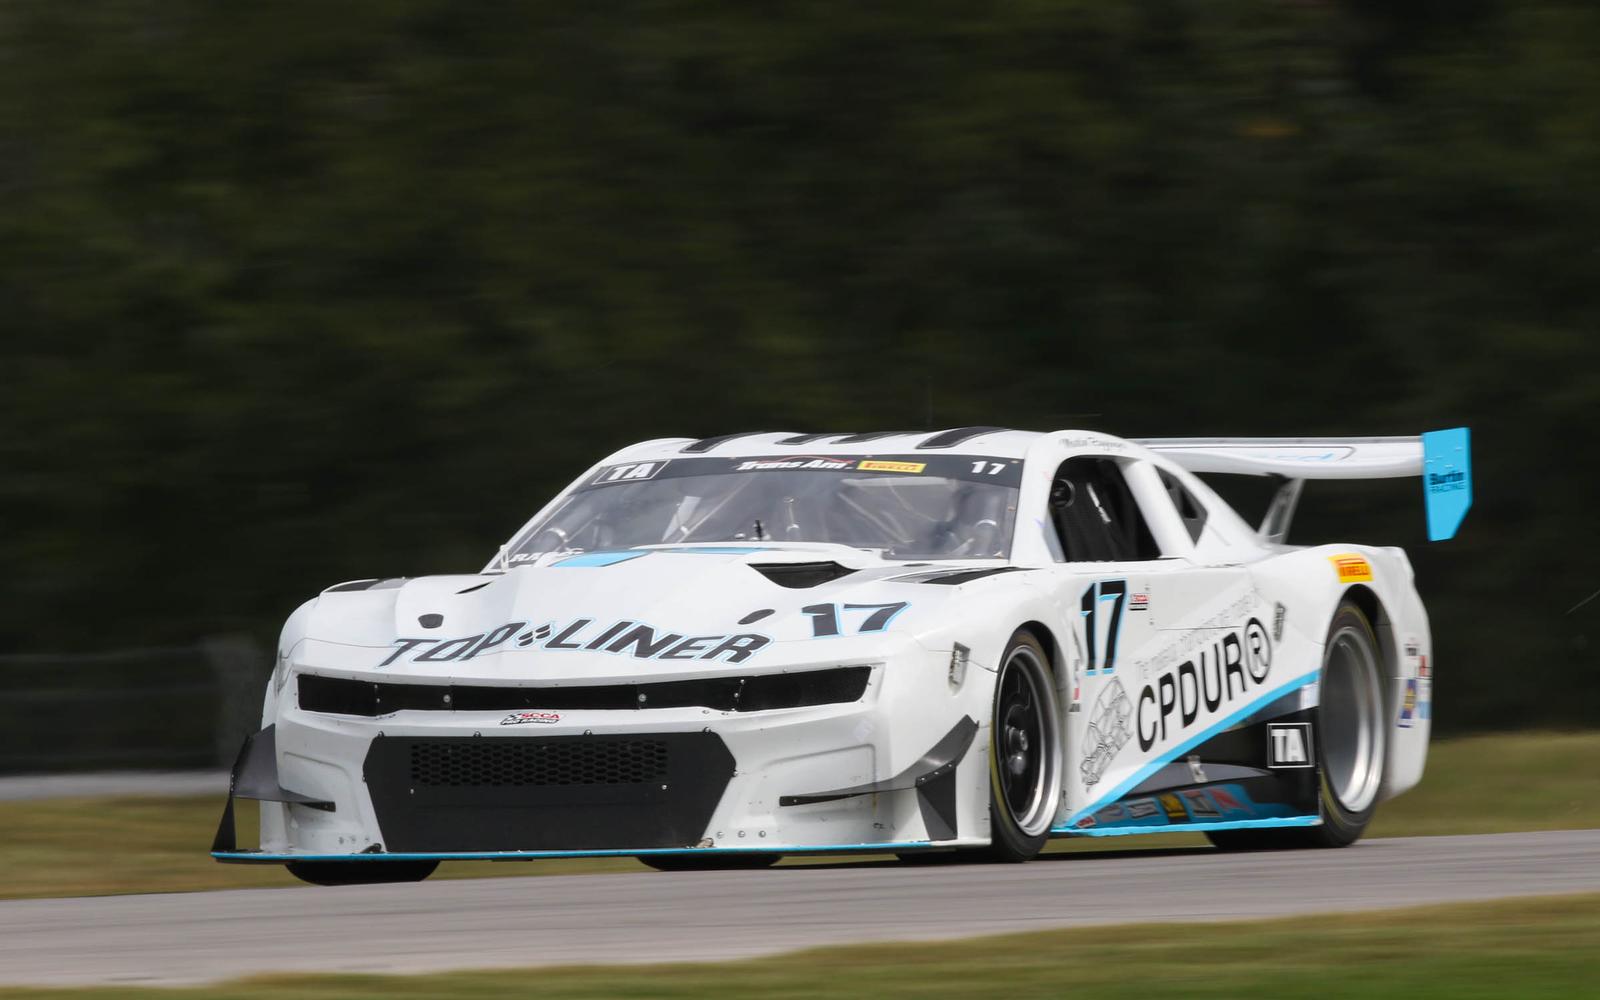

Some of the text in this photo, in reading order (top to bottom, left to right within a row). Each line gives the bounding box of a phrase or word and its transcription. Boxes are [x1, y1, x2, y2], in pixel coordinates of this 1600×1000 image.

[607, 463, 655, 481] TA
[736, 461, 804, 470] Trans
[970, 461, 1006, 475] 17
[801, 602, 910, 637] 17
[1080, 579, 1126, 674] 17
[378, 619, 771, 668] TOP LINER
[1271, 728, 1307, 762] TA
